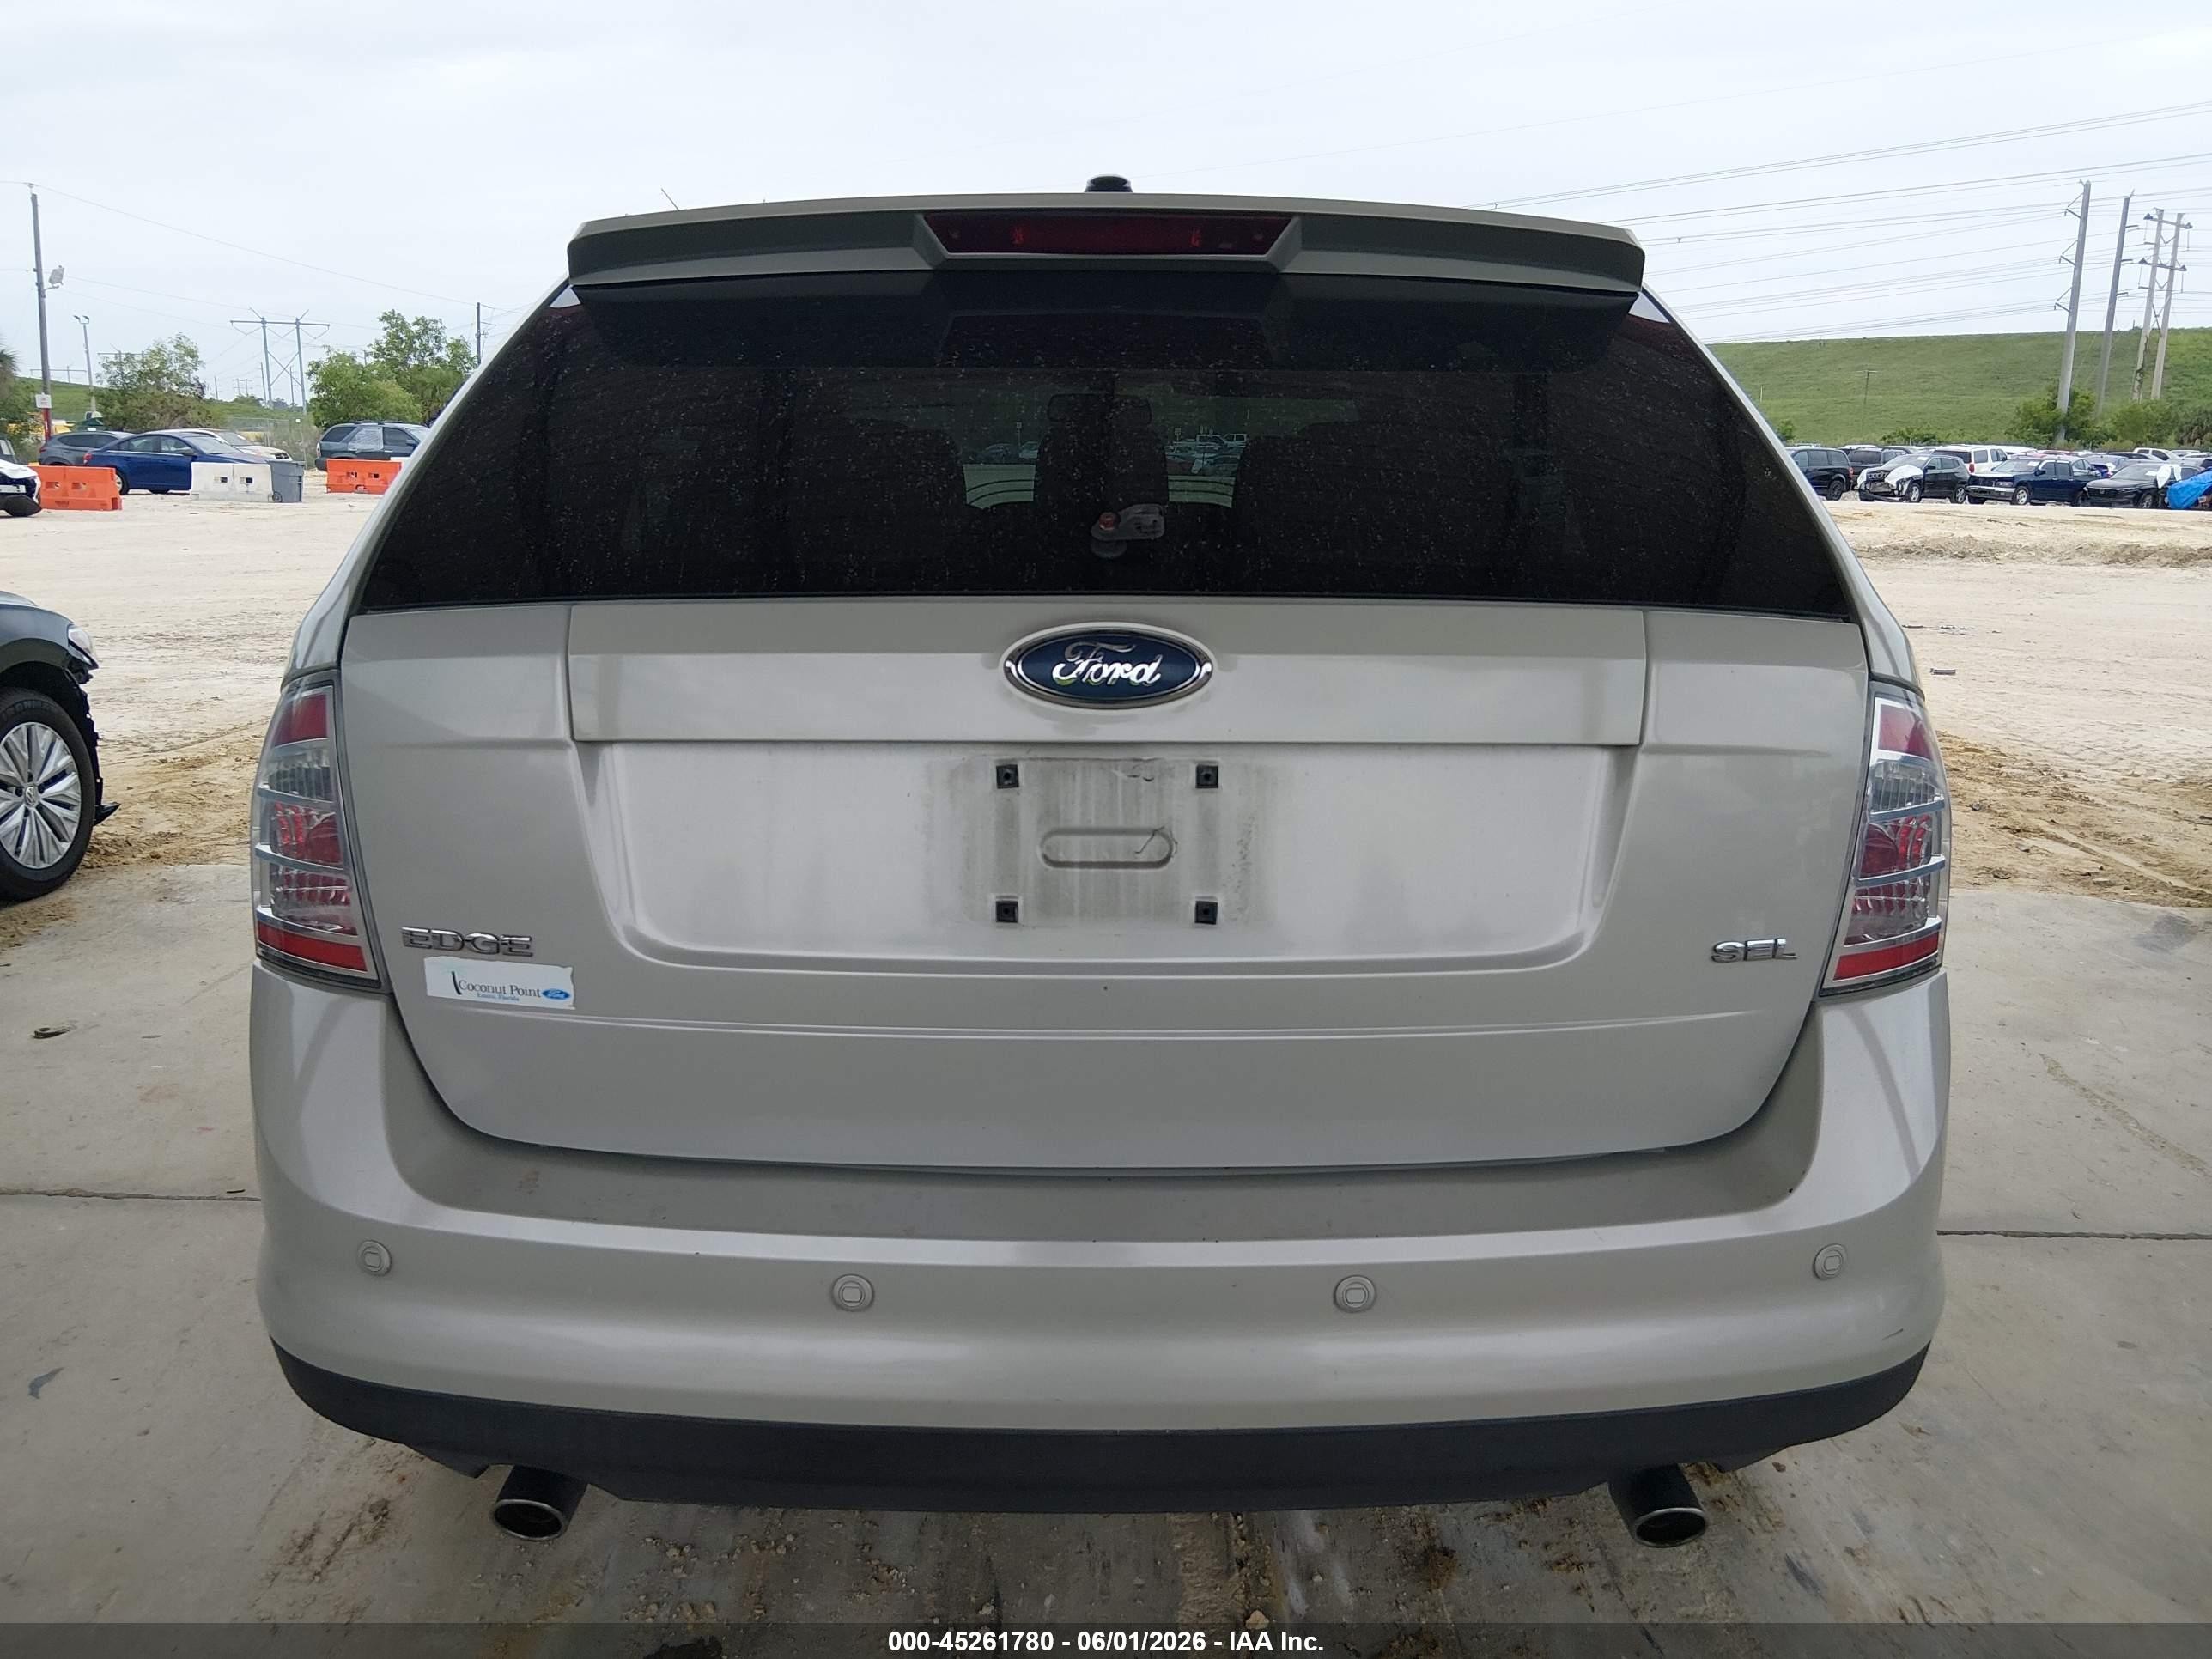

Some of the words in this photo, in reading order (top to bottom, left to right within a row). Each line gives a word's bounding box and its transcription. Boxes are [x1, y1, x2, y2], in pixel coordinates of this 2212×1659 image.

[1052, 641, 1162, 686] Ford
[401, 926, 533, 957] EDGE
[1710, 938, 1798, 963] SEL
[459, 979, 507, 994] Coconut
[510, 984, 542, 998] Point
